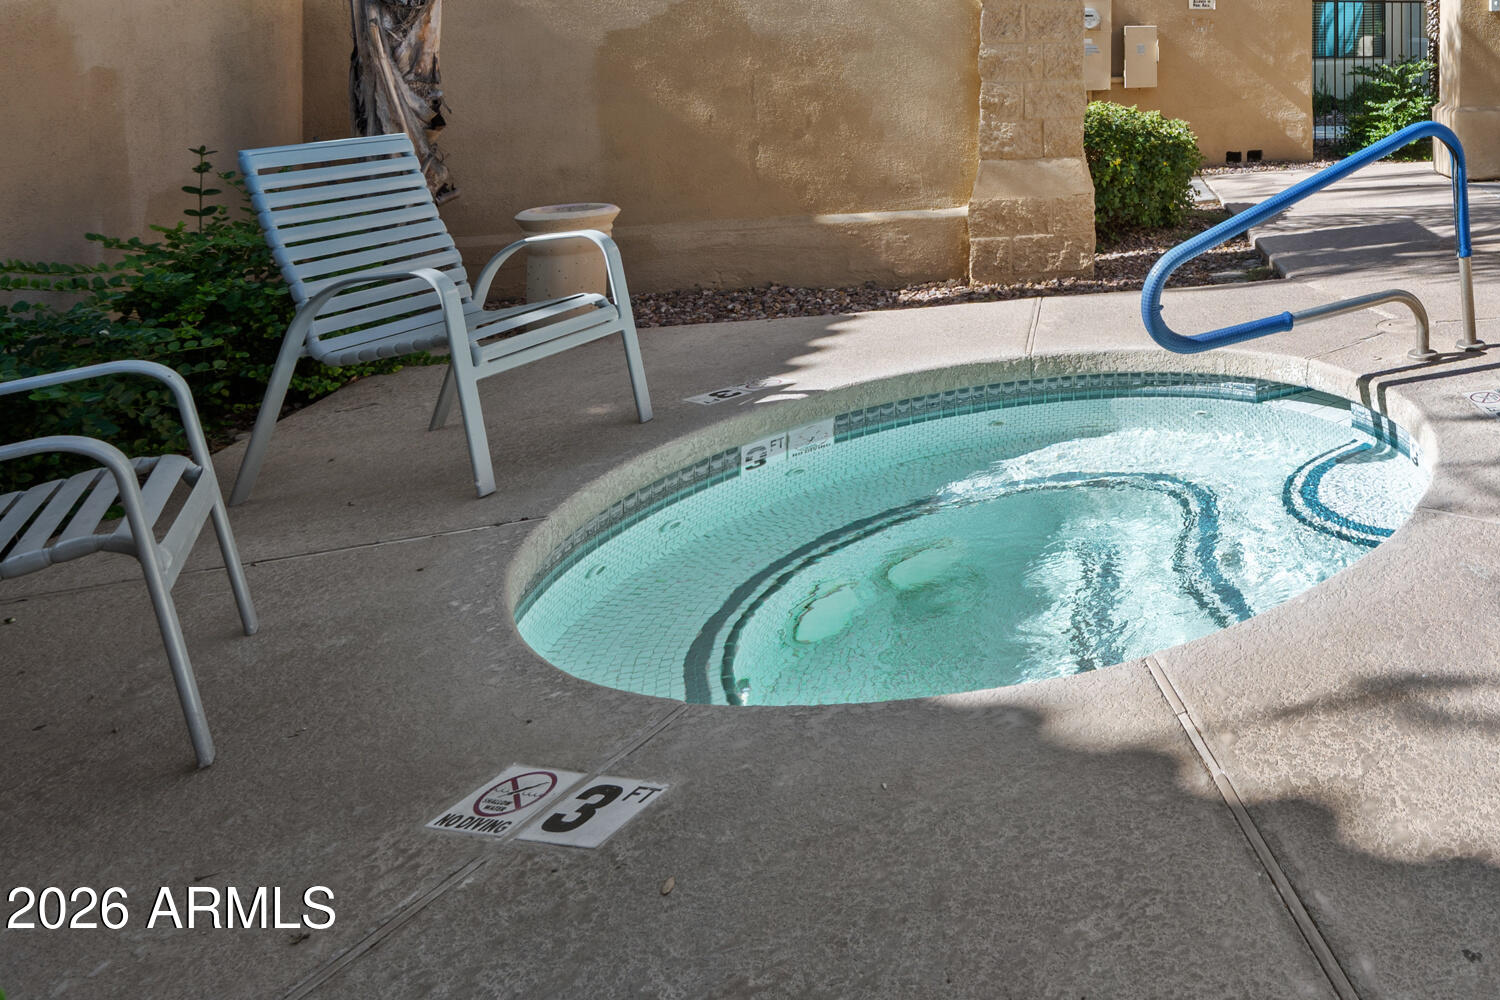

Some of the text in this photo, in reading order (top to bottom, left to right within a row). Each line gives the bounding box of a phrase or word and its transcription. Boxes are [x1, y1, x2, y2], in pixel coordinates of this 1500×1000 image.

[433, 813, 513, 833] NO DIVING
[541, 784, 663, 833] 3 FT
